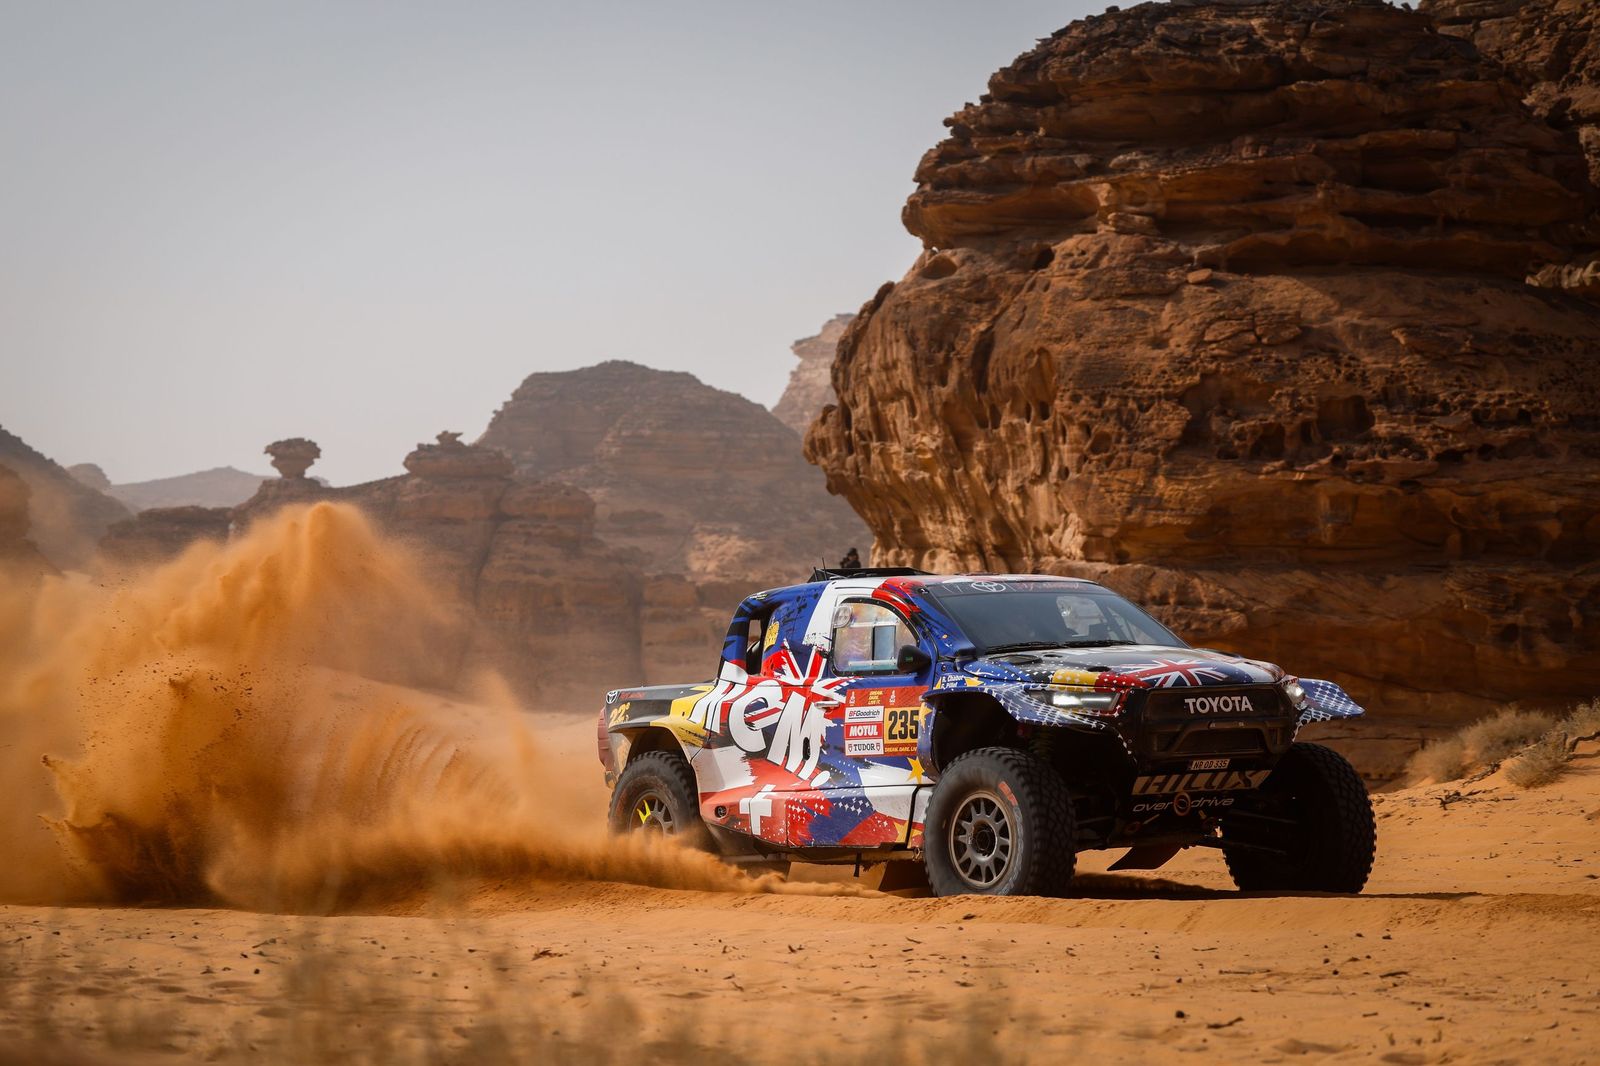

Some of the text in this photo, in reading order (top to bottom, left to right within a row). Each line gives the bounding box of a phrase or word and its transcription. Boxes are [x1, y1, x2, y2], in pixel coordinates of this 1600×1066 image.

[1184, 696, 1254, 714] TOYOTA
[849, 725, 878, 737] MOTUL
[888, 710, 919, 740] 235
[853, 743, 876, 751] TUDOR
